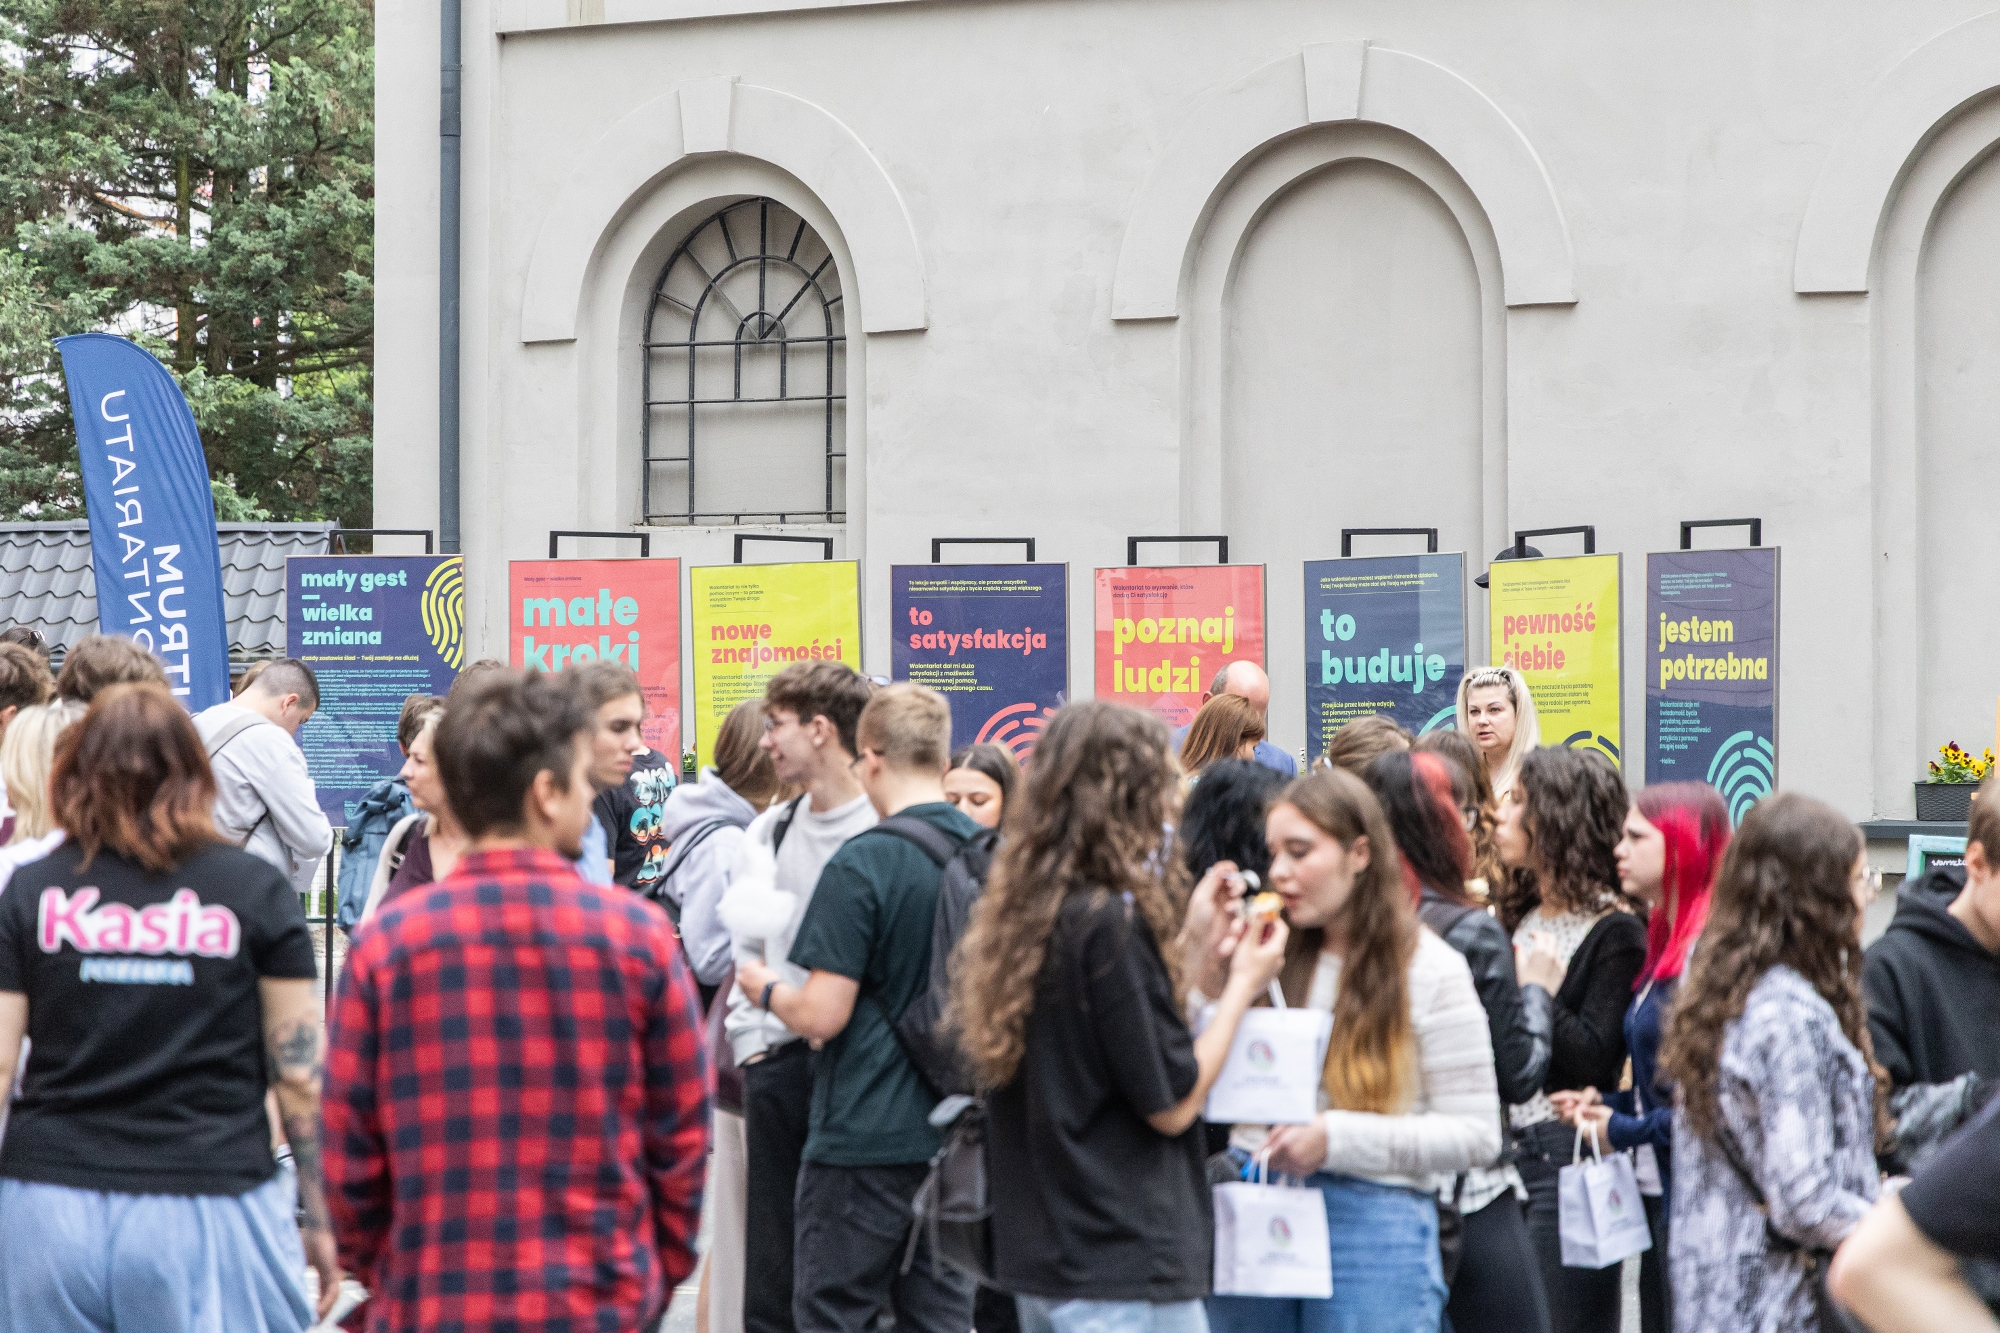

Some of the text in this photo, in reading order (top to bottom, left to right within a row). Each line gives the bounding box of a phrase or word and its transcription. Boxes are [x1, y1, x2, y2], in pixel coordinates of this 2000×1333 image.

[301, 569, 407, 592] mały gest
[302, 602, 372, 622] wielka
[523, 588, 638, 626] małe
[909, 606, 933, 626] to
[1320, 608, 1356, 641] to
[1503, 602, 1596, 645] pewność
[302, 626, 382, 645] zmiana
[711, 623, 772, 641] nowe
[909, 626, 1047, 656] satysfakcja
[1113, 606, 1235, 655] poznaj
[1659, 612, 1734, 652] jestem
[523, 630, 640, 673] kroki
[711, 638, 842, 669] znajomości
[1322, 642, 1446, 694] buduje
[909, 678, 954, 686] bezinteresownej
[1113, 655, 1200, 693] ludzi
[1660, 651, 1768, 690] potrzebna
[39, 887, 240, 959] Kasia
